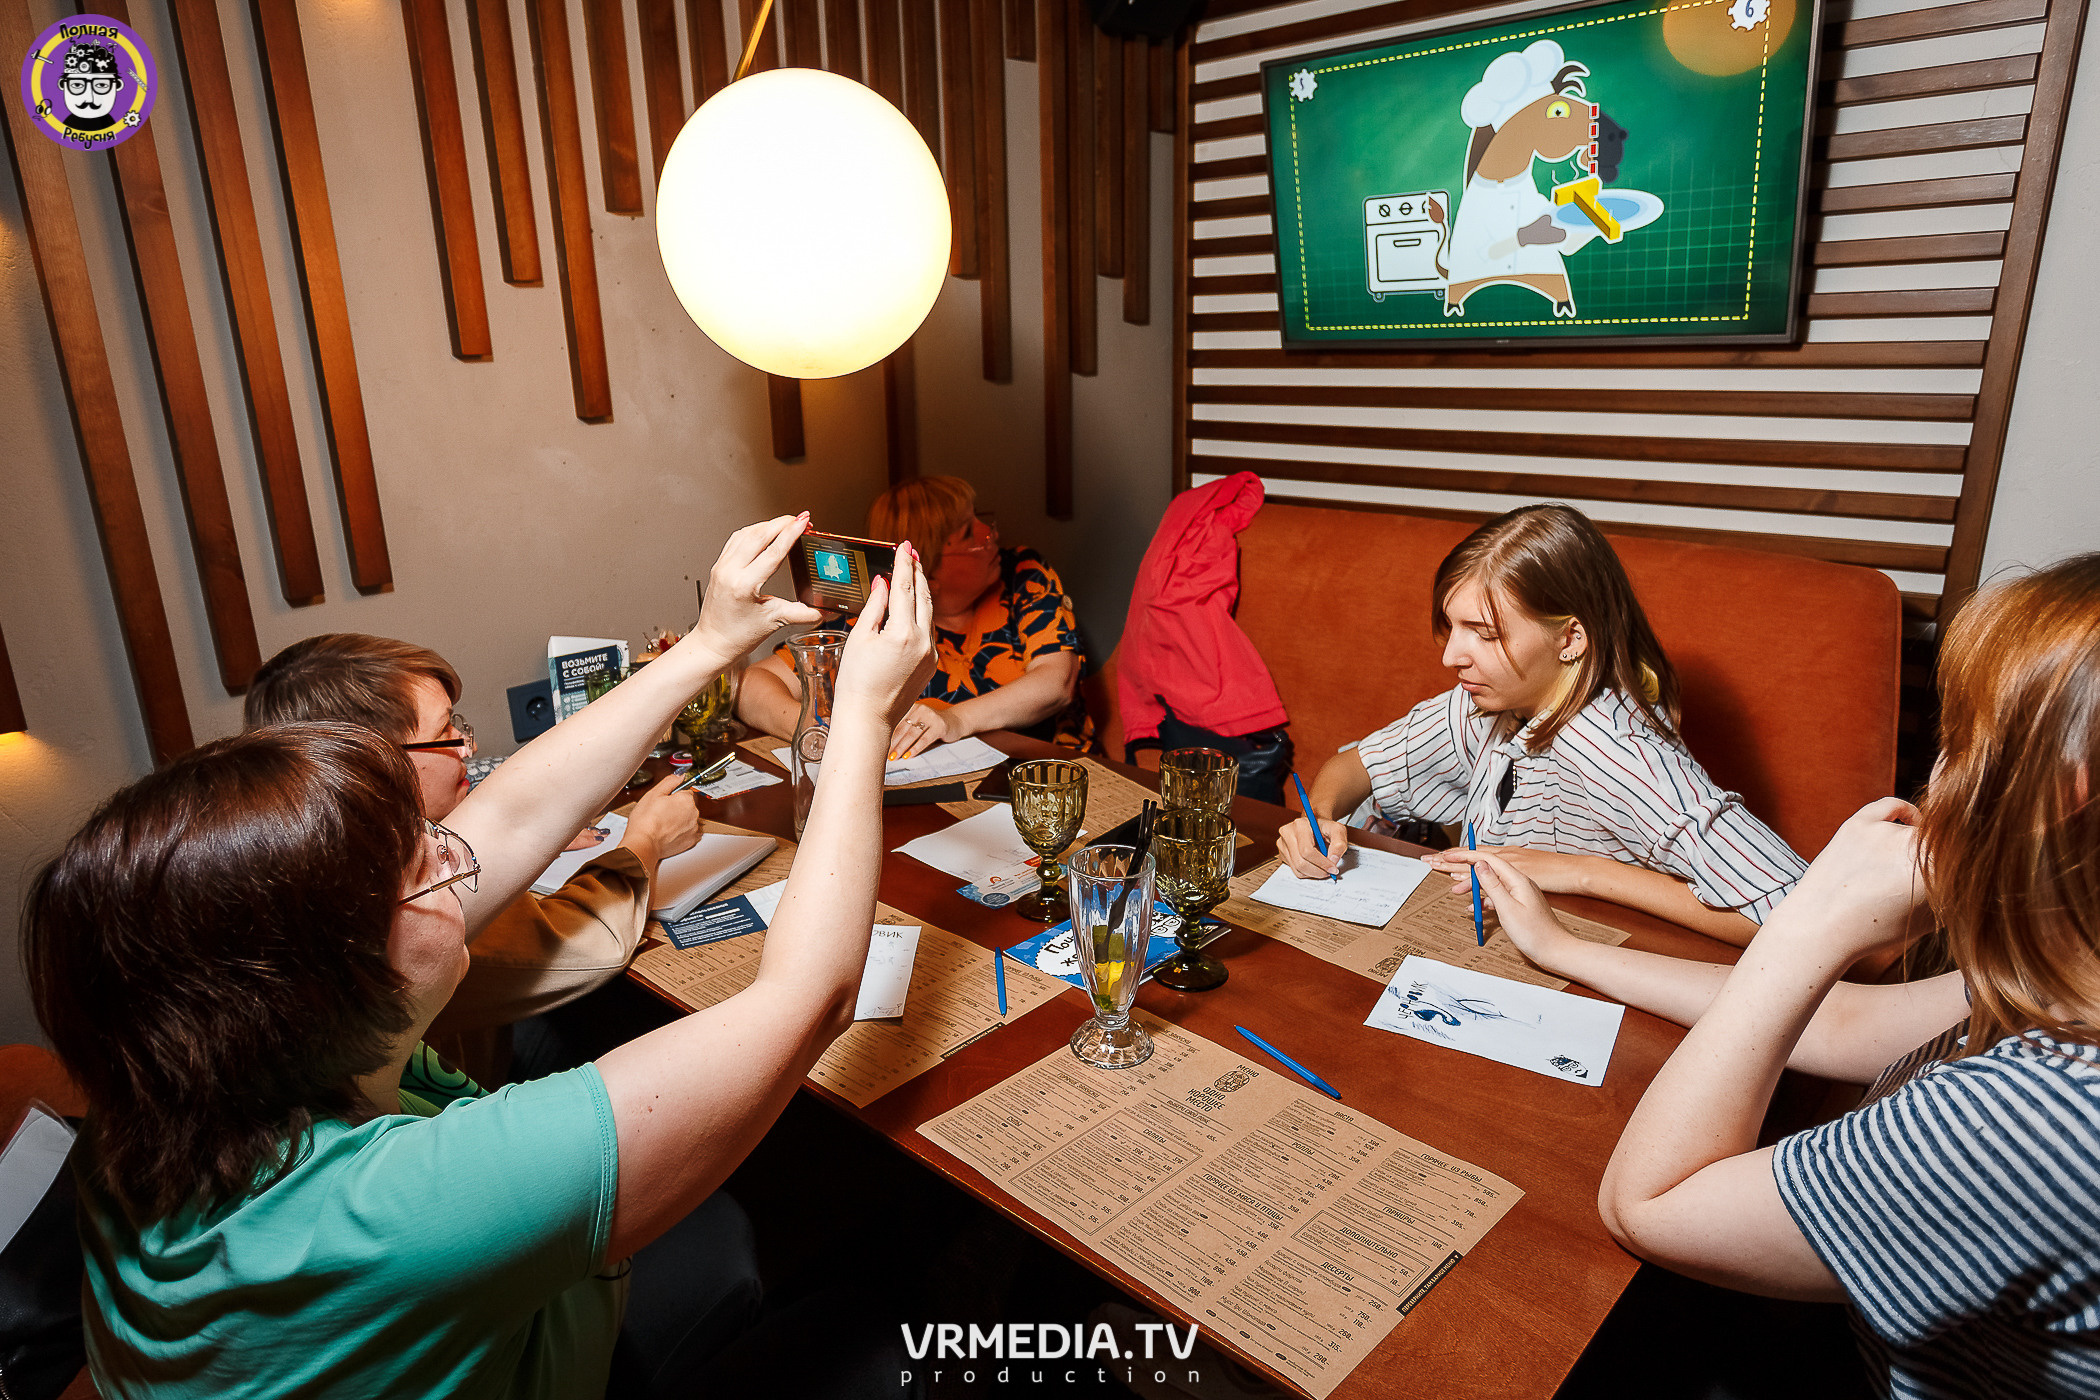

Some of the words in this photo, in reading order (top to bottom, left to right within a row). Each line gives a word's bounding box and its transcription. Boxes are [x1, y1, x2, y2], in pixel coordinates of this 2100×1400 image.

[561, 653, 608, 670] ВОЗЬМИТЕ
[562, 669, 570, 678] С
[1236, 1064, 1260, 1077] МЕНЮ
[1202, 1086, 1226, 1101] ОДНО
[1185, 1096, 1213, 1112] МЕСТО
[1334, 1111, 1354, 1122] ПАСТА
[1143, 1128, 1167, 1144] САЛАТЫ
[1291, 1142, 1315, 1156] РОЛЛЫ
[1420, 1153, 1449, 1169] ГОРЯЧЕЕ
[1450, 1165, 1461, 1173] ИЗ
[1460, 1170, 1483, 1183] РЫБЫ
[1203, 1173, 1230, 1190] ГОРЯЧЕЕ
[1227, 1187, 1238, 1195] ИЗ
[1236, 1192, 1256, 1205] МЯСА
[1260, 1205, 1284, 1221] ПТИЦЫ
[1382, 1206, 1416, 1224] ГАРНИРЫ
[1339, 1226, 1399, 1261] ДОПОЛНИТЕЛЬНО
[1320, 1261, 1355, 1282] ДЕСЕРТЫ
[1399, 1268, 1411, 1278] 50.-
[1389, 1278, 1400, 1287] 10.-
[1368, 1299, 1384, 1312] 250.-
[1357, 1310, 1372, 1323] 750.-
[1338, 1328, 1354, 1341] 260.-
[1327, 1340, 1342, 1353] 315.-
[1313, 1352, 1330, 1366] 290.-
